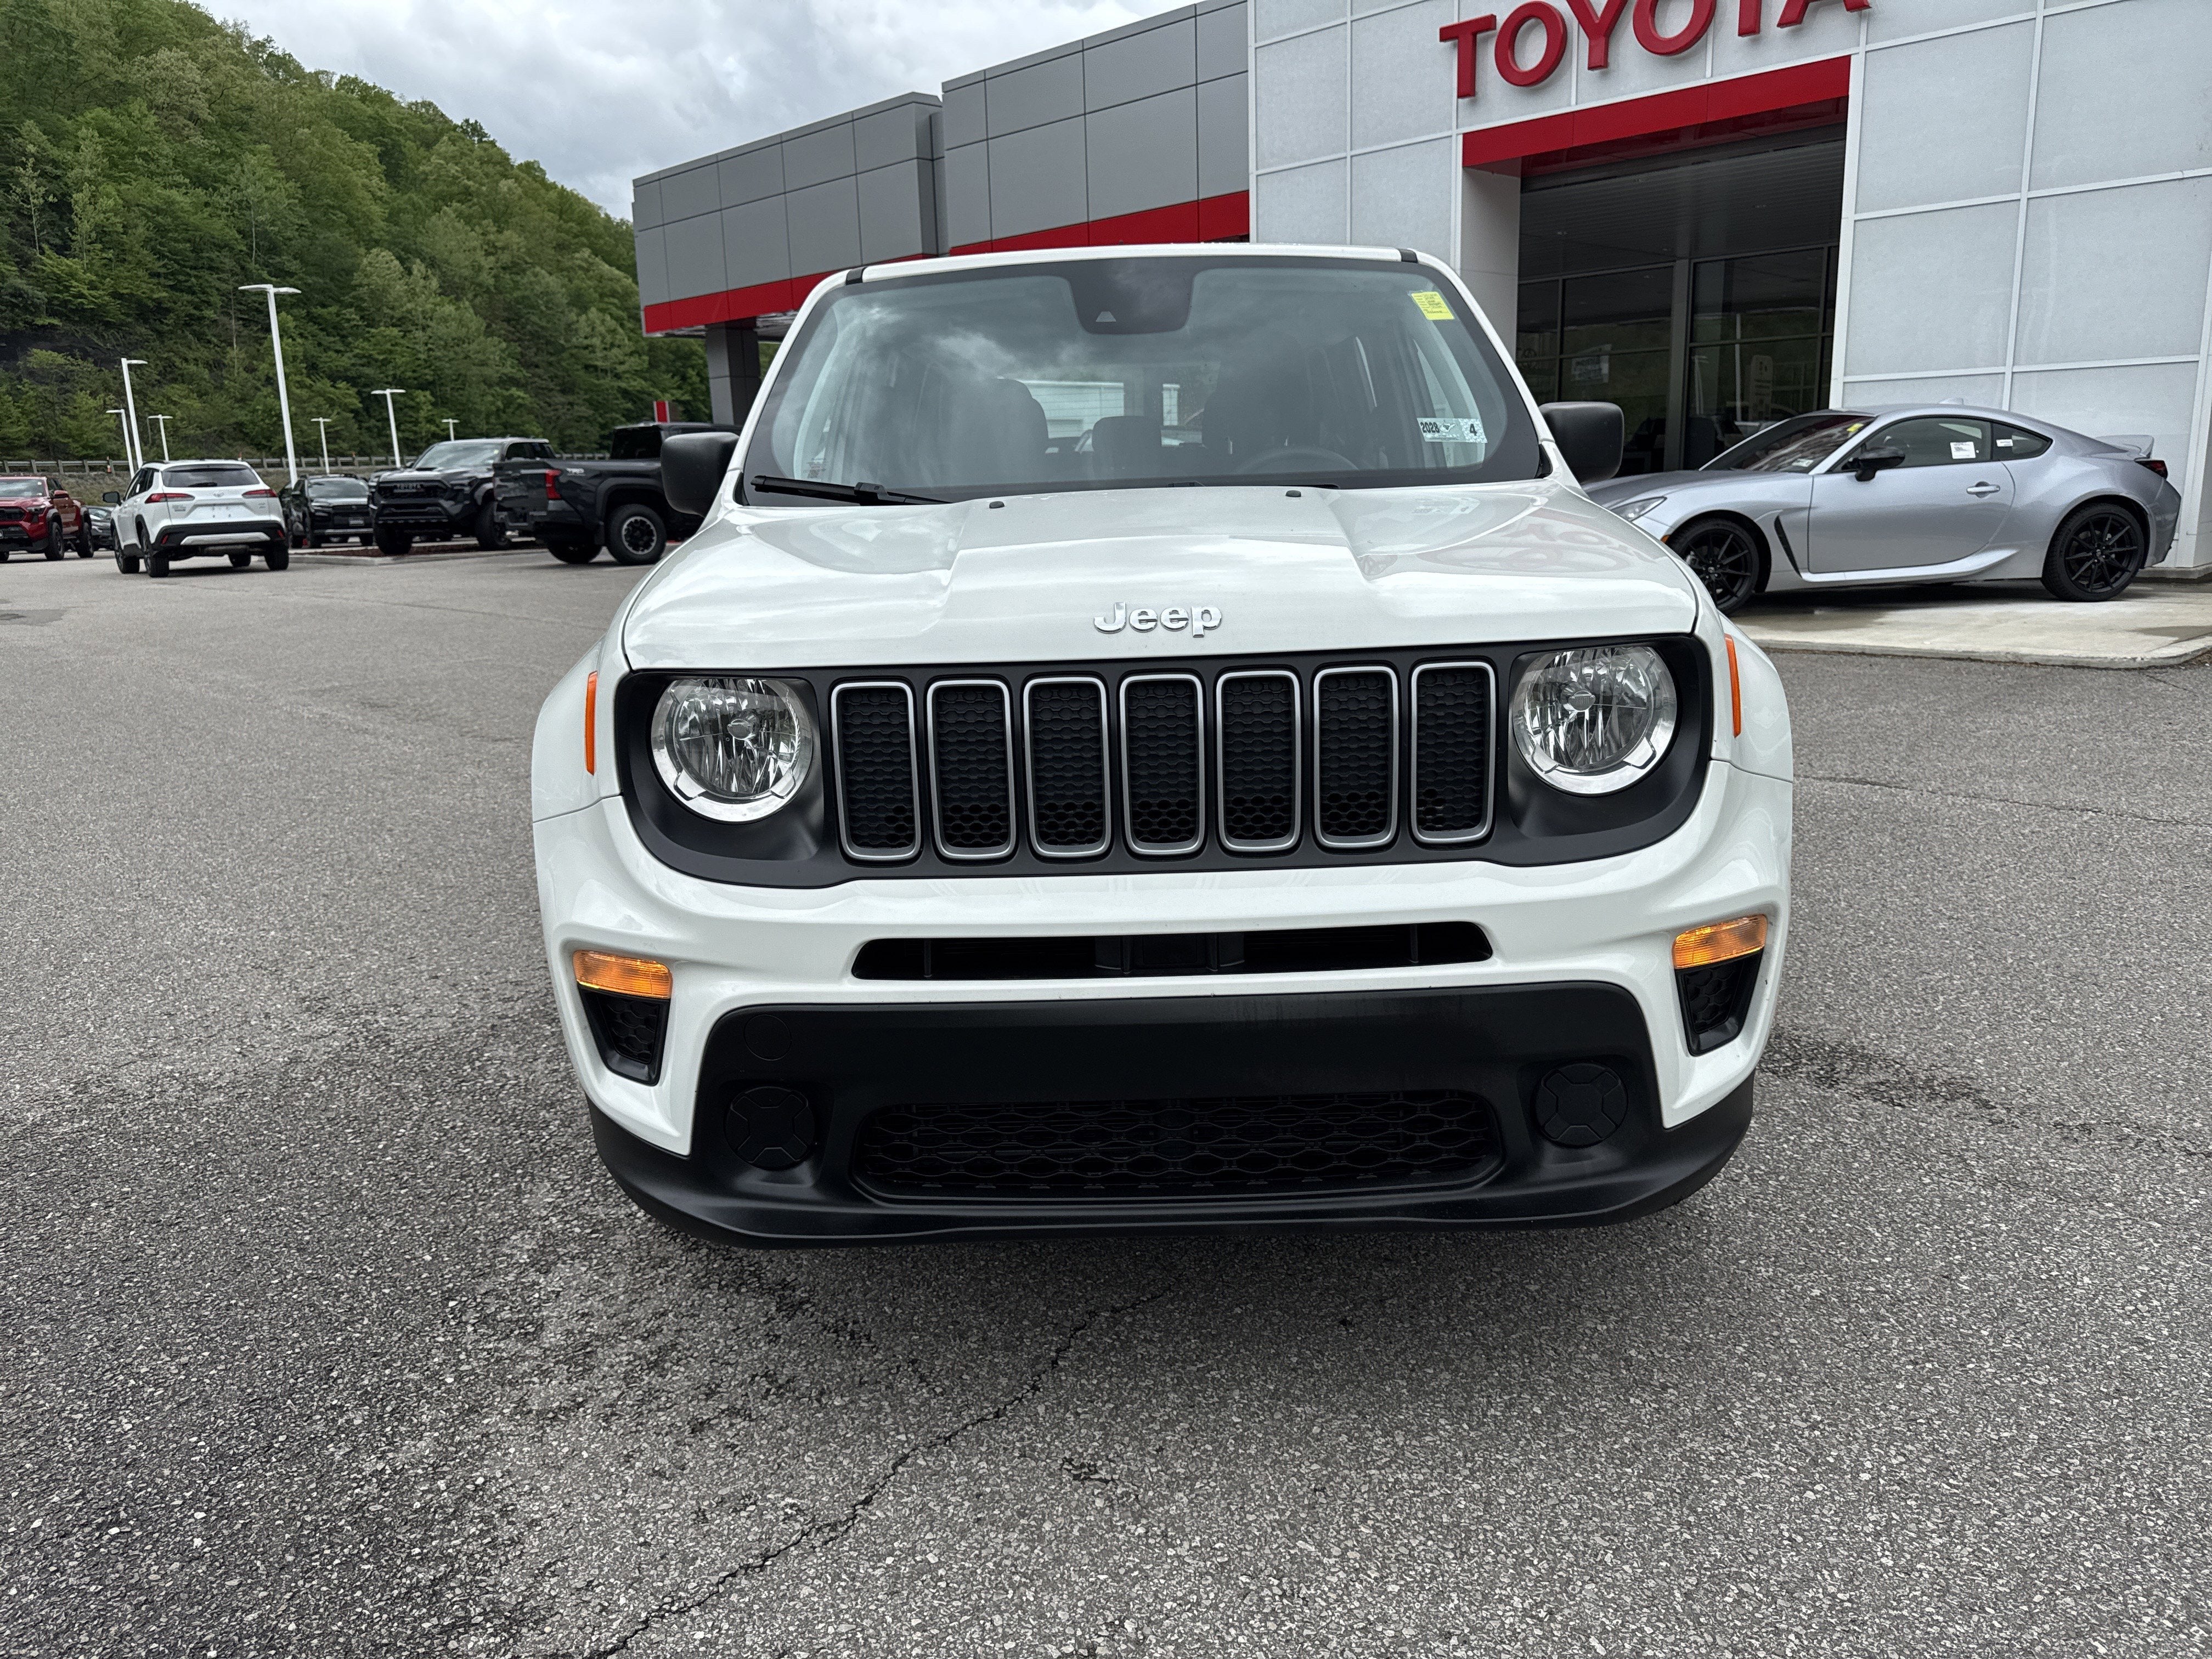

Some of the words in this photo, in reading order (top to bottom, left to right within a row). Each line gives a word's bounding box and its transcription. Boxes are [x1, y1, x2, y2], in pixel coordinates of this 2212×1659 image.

[1440, 0, 1871, 99] TOYO
[1420, 422, 1440, 433] 2028
[1469, 424, 1477, 436] 4
[1094, 602, 1222, 637] Jeep
